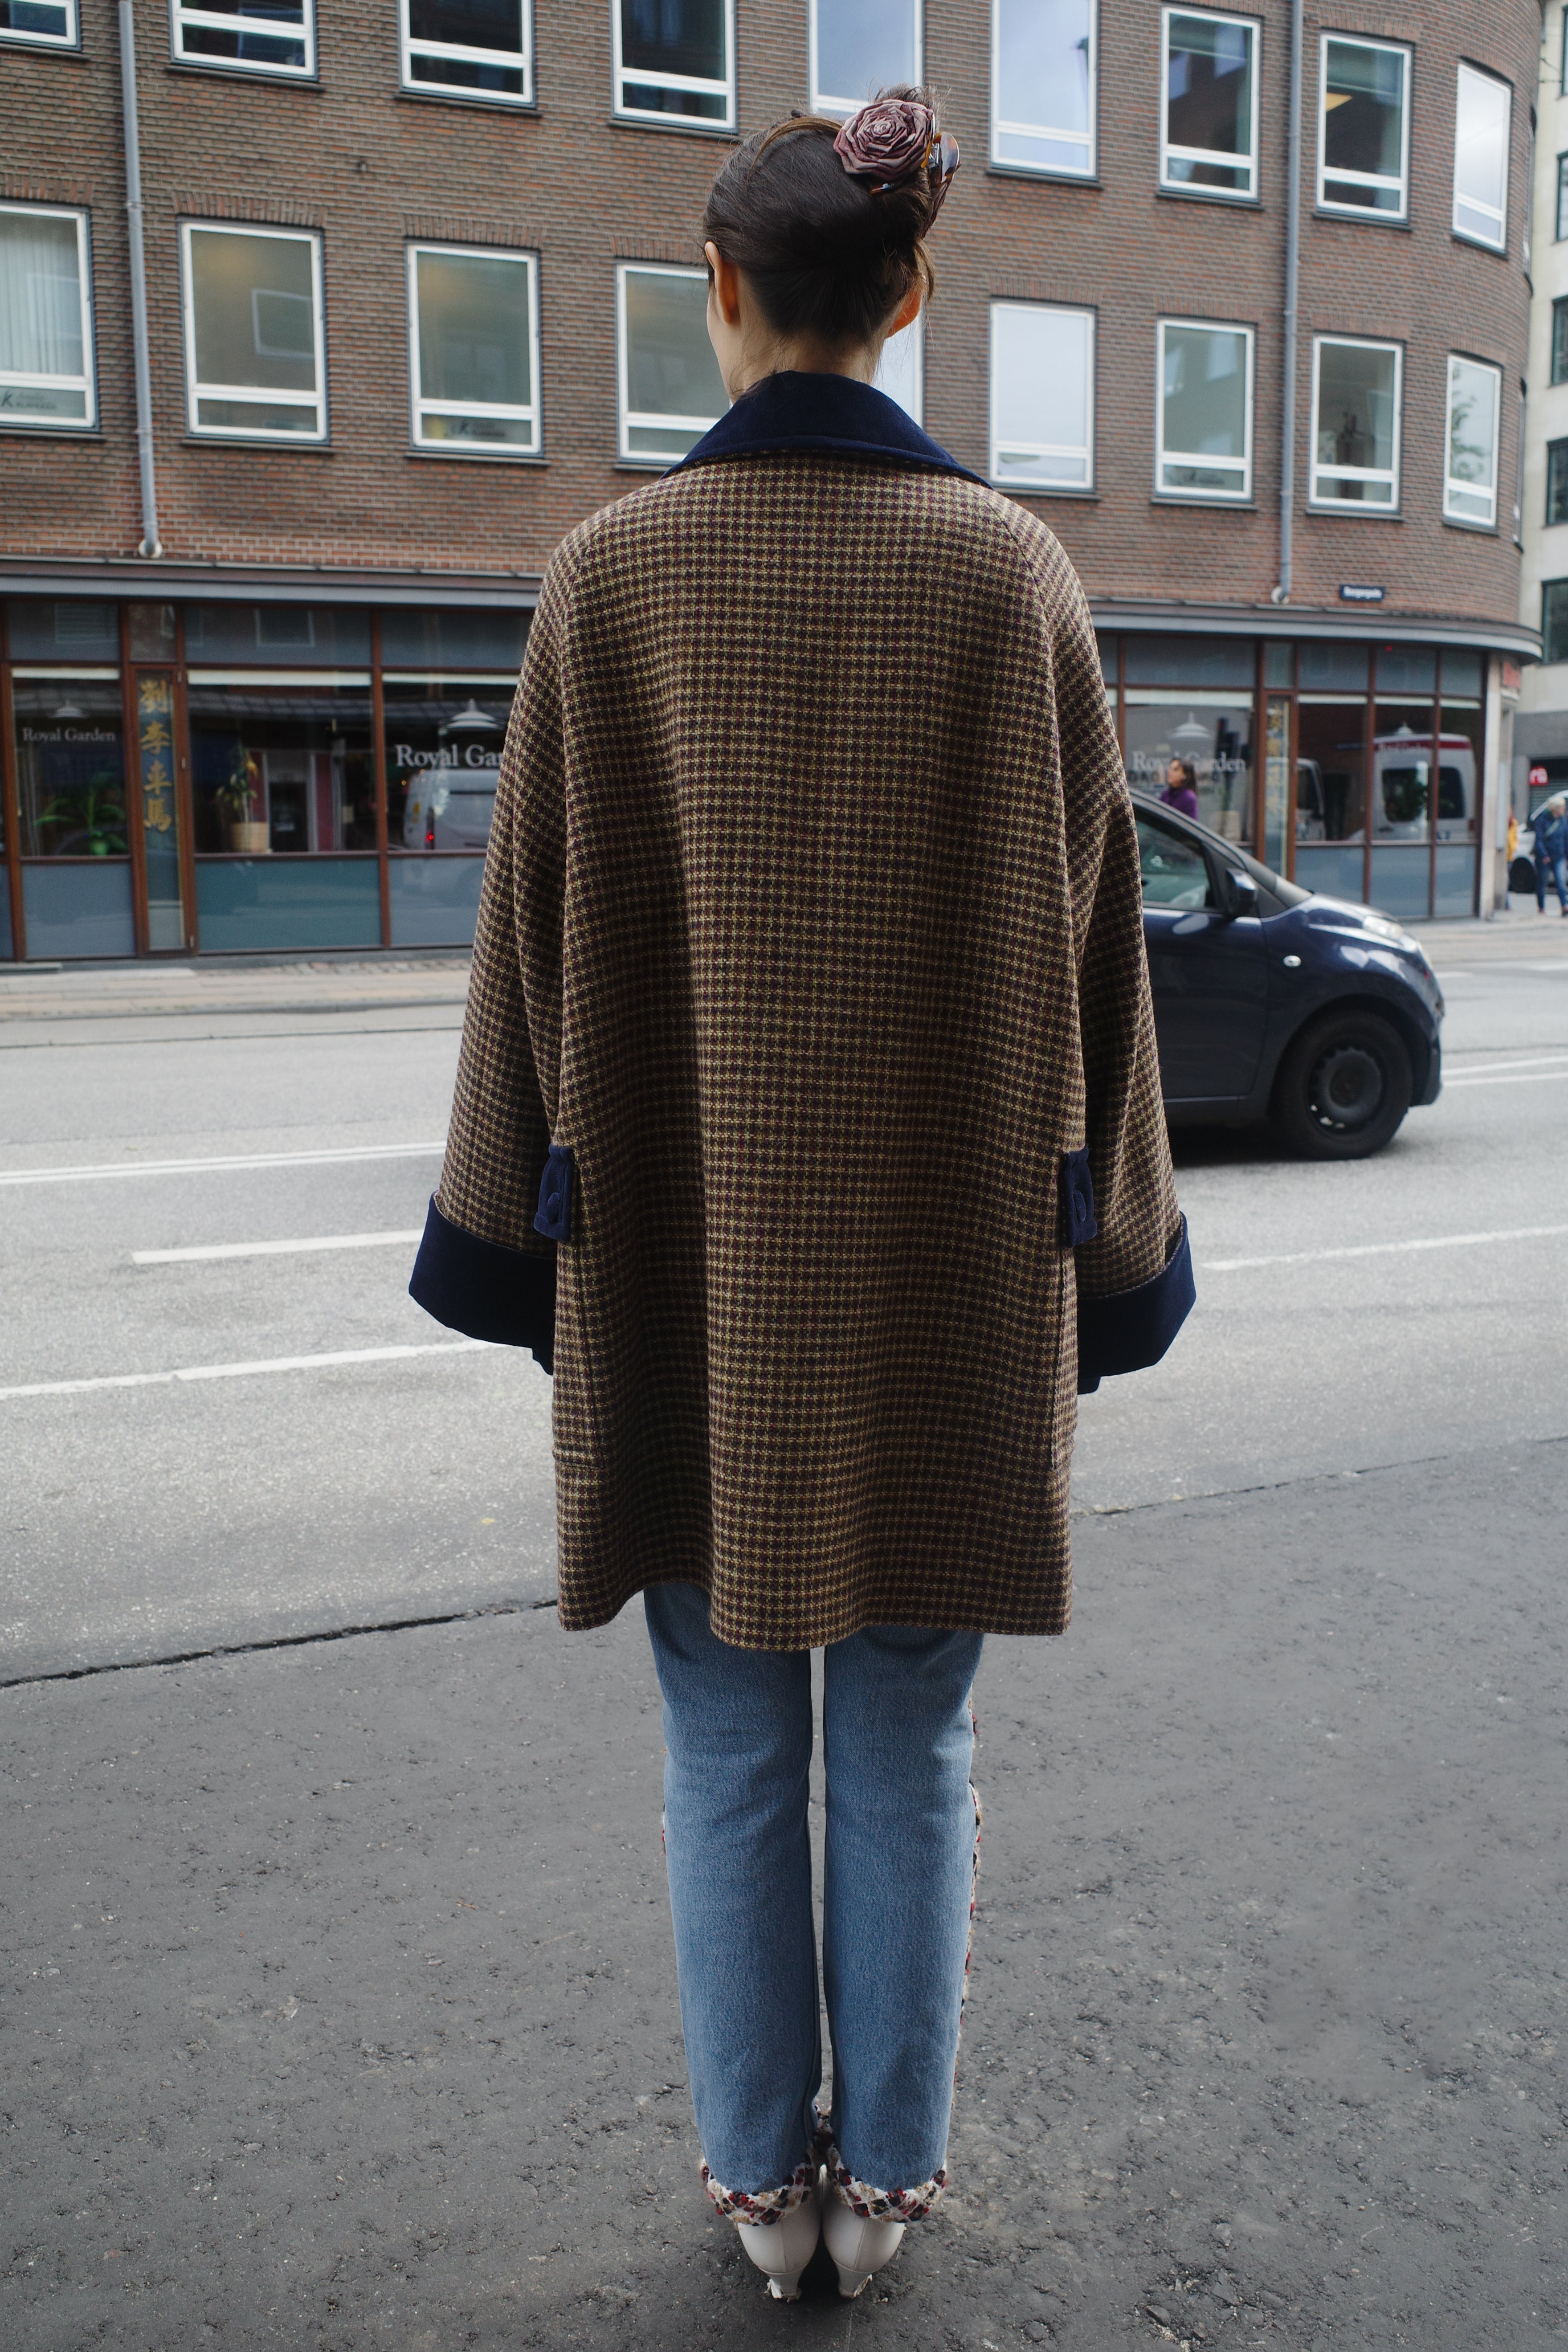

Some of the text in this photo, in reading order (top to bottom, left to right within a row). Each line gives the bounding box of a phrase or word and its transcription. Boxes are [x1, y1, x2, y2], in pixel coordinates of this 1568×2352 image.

[23, 727, 116, 744] Royal Garden
[394, 743, 460, 771] Royal
